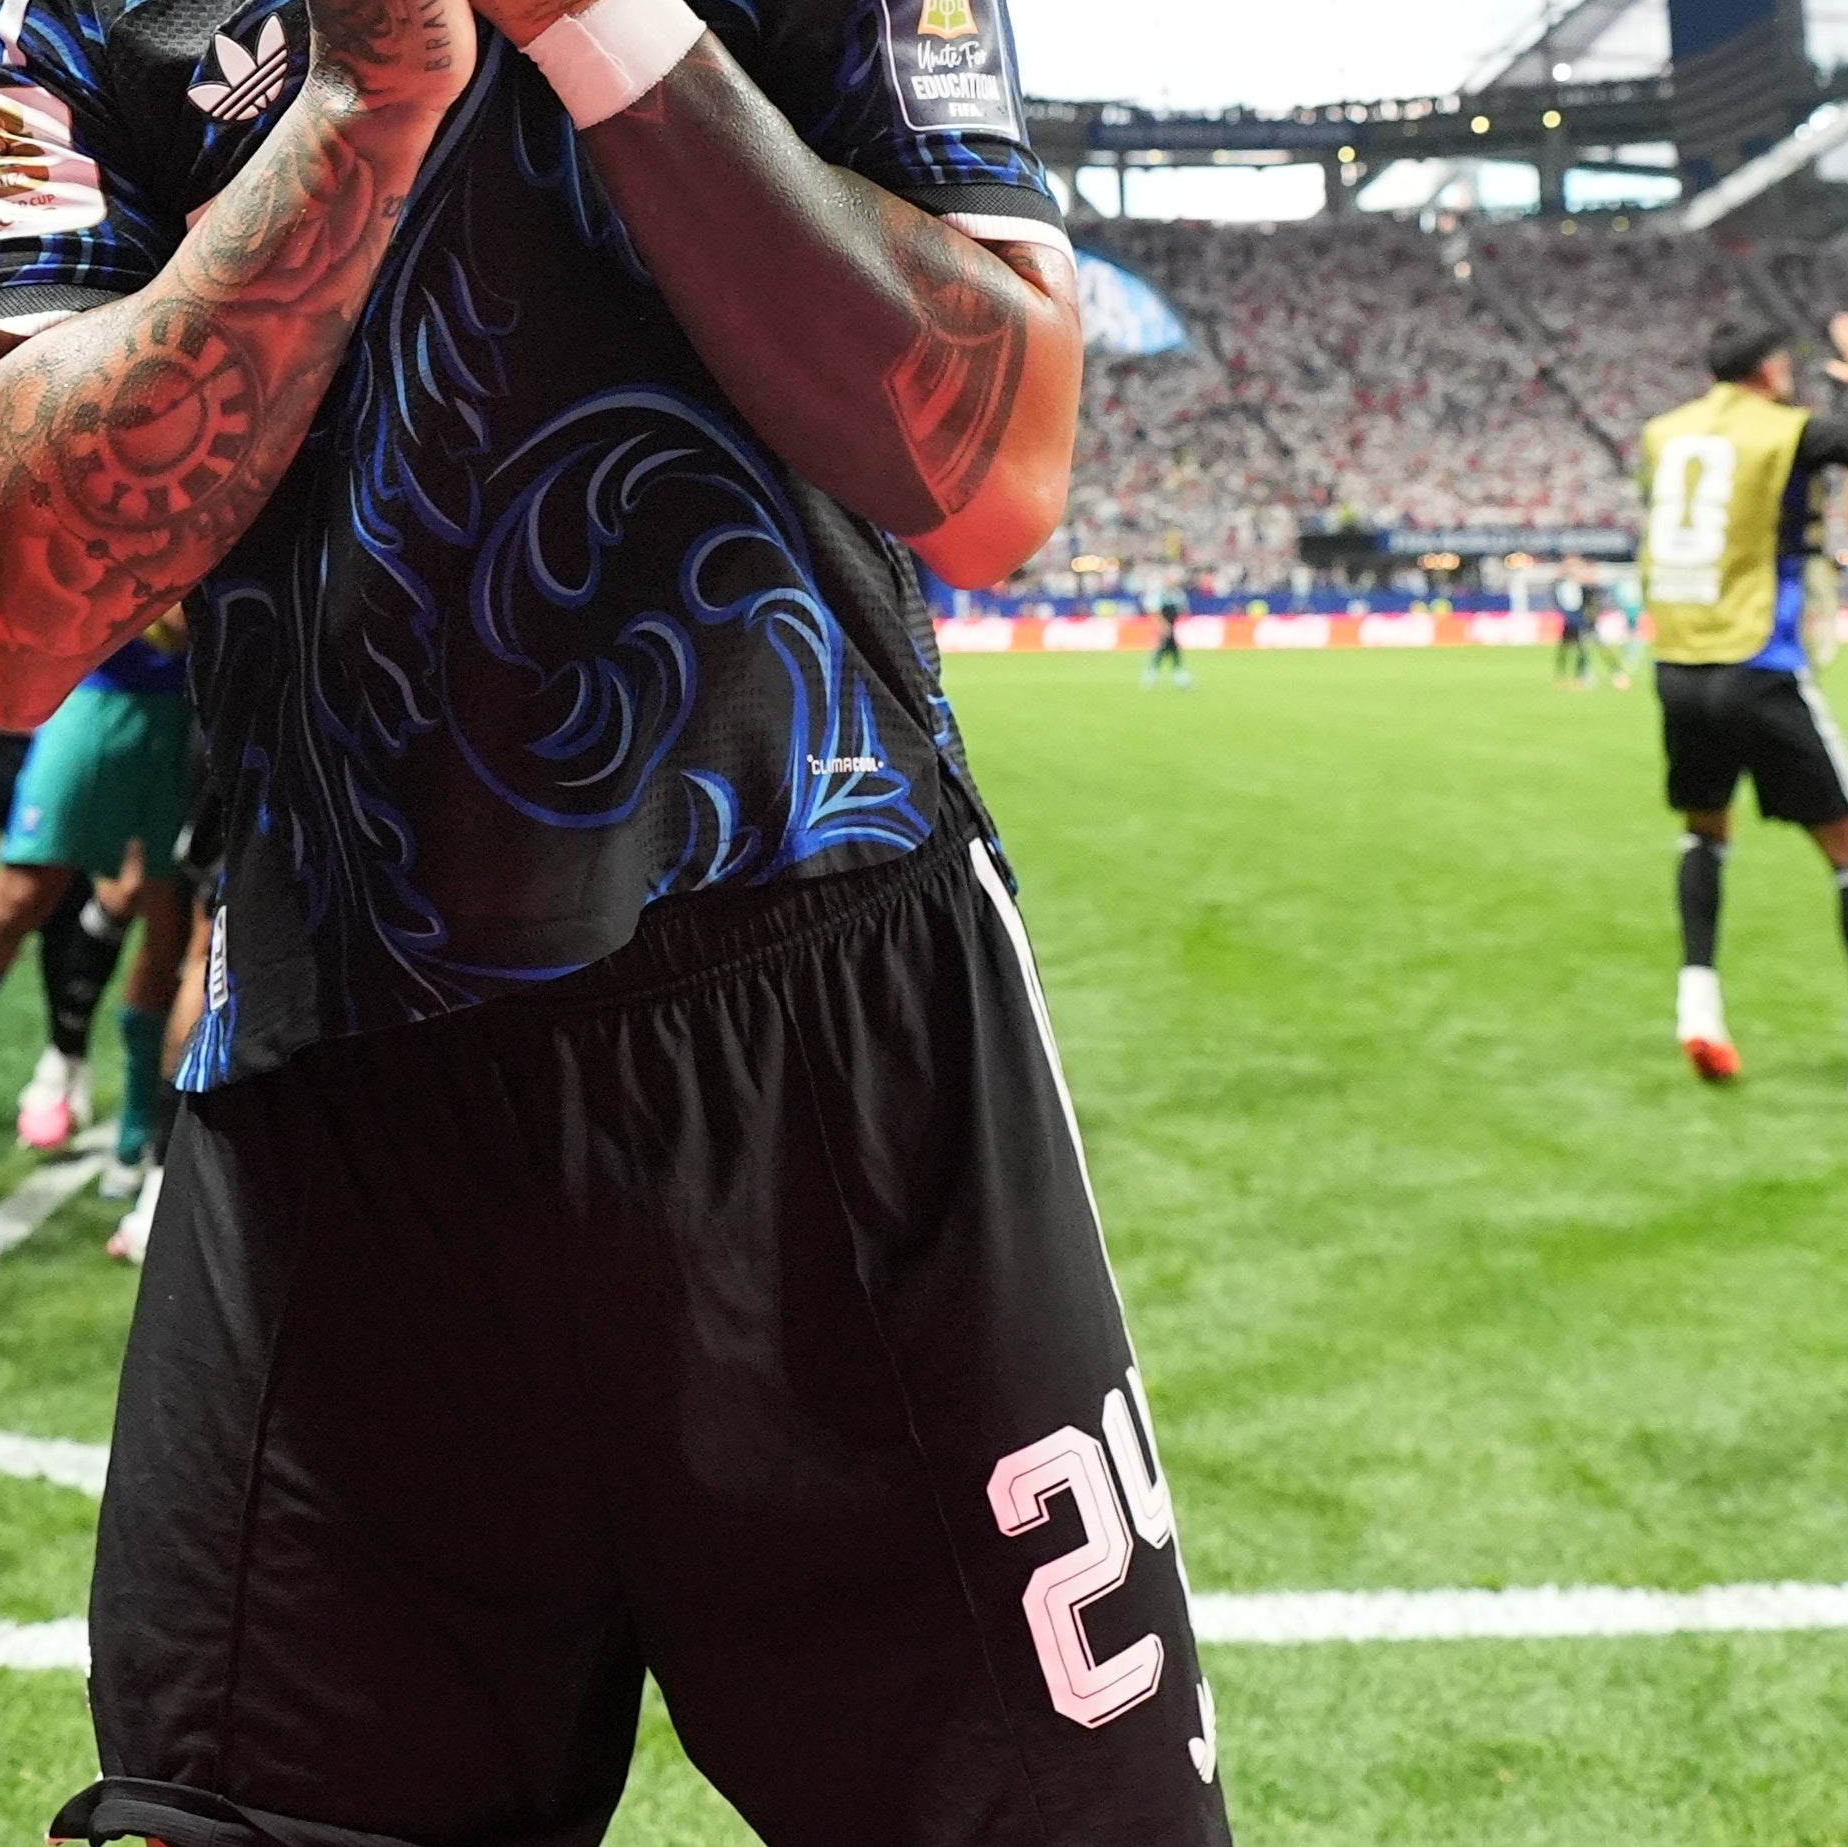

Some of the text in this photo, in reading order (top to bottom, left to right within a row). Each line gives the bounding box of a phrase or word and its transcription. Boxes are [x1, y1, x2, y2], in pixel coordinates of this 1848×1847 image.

[917, 40, 988, 74] Unite For
[911, 73, 1000, 101] EDUCATION
[29, 194, 55, 206] CUP
[811, 756, 879, 775] CLIMACOOL
